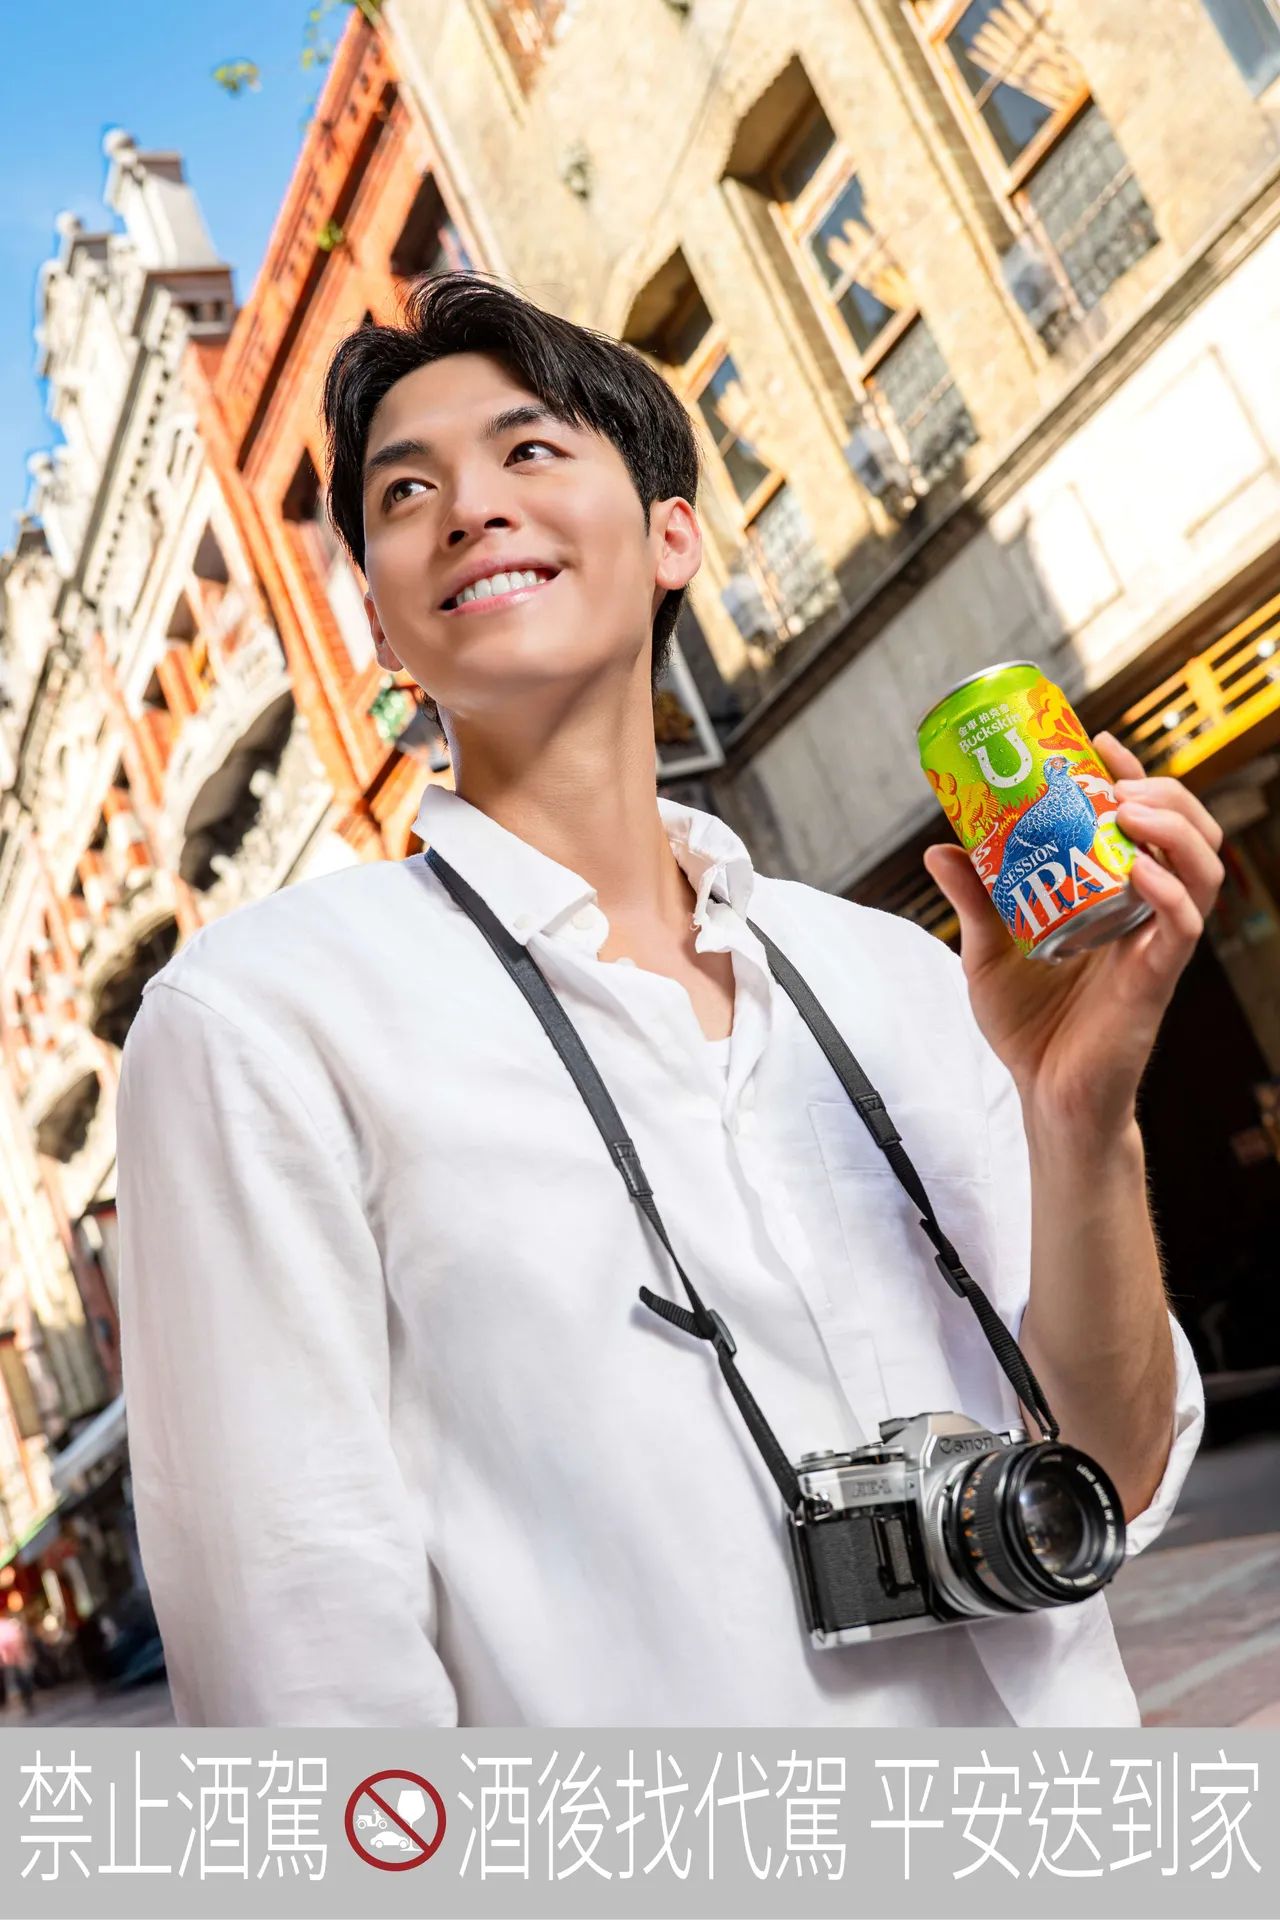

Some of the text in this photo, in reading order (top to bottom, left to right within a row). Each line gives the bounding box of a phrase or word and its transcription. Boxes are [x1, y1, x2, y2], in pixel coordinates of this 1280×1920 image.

[958, 713, 1022, 754] Buckskin
[1001, 840, 1060, 890] SESSION
[1007, 845, 1122, 940] IPA
[939, 1436, 994, 1455] Canon
